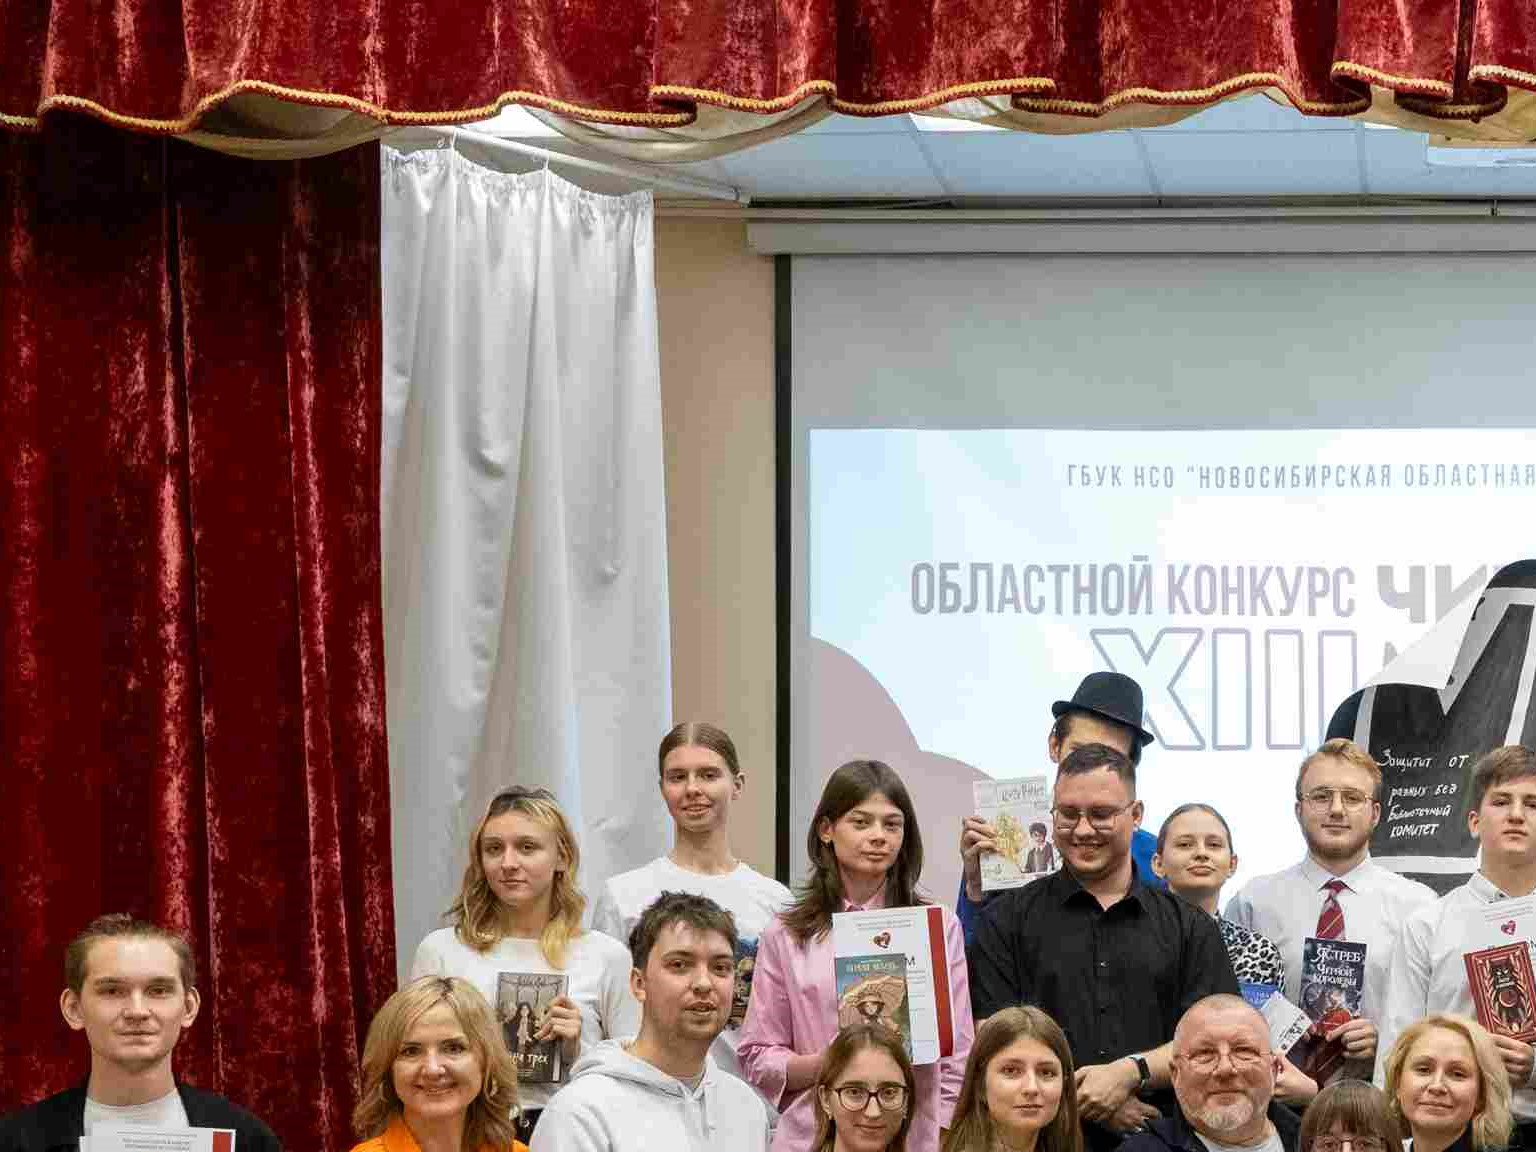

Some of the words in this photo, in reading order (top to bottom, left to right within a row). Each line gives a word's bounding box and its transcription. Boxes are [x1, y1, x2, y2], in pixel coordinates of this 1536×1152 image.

[1067, 464, 1121, 487] ГБУК
[1135, 465, 1175, 488] НСО
[1404, 464, 1536, 487] ОБЛАСТНАЯ
[911, 555, 1153, 615] ОБЛАСТНОЙ
[1166, 564, 1356, 616] КОНКУРС
